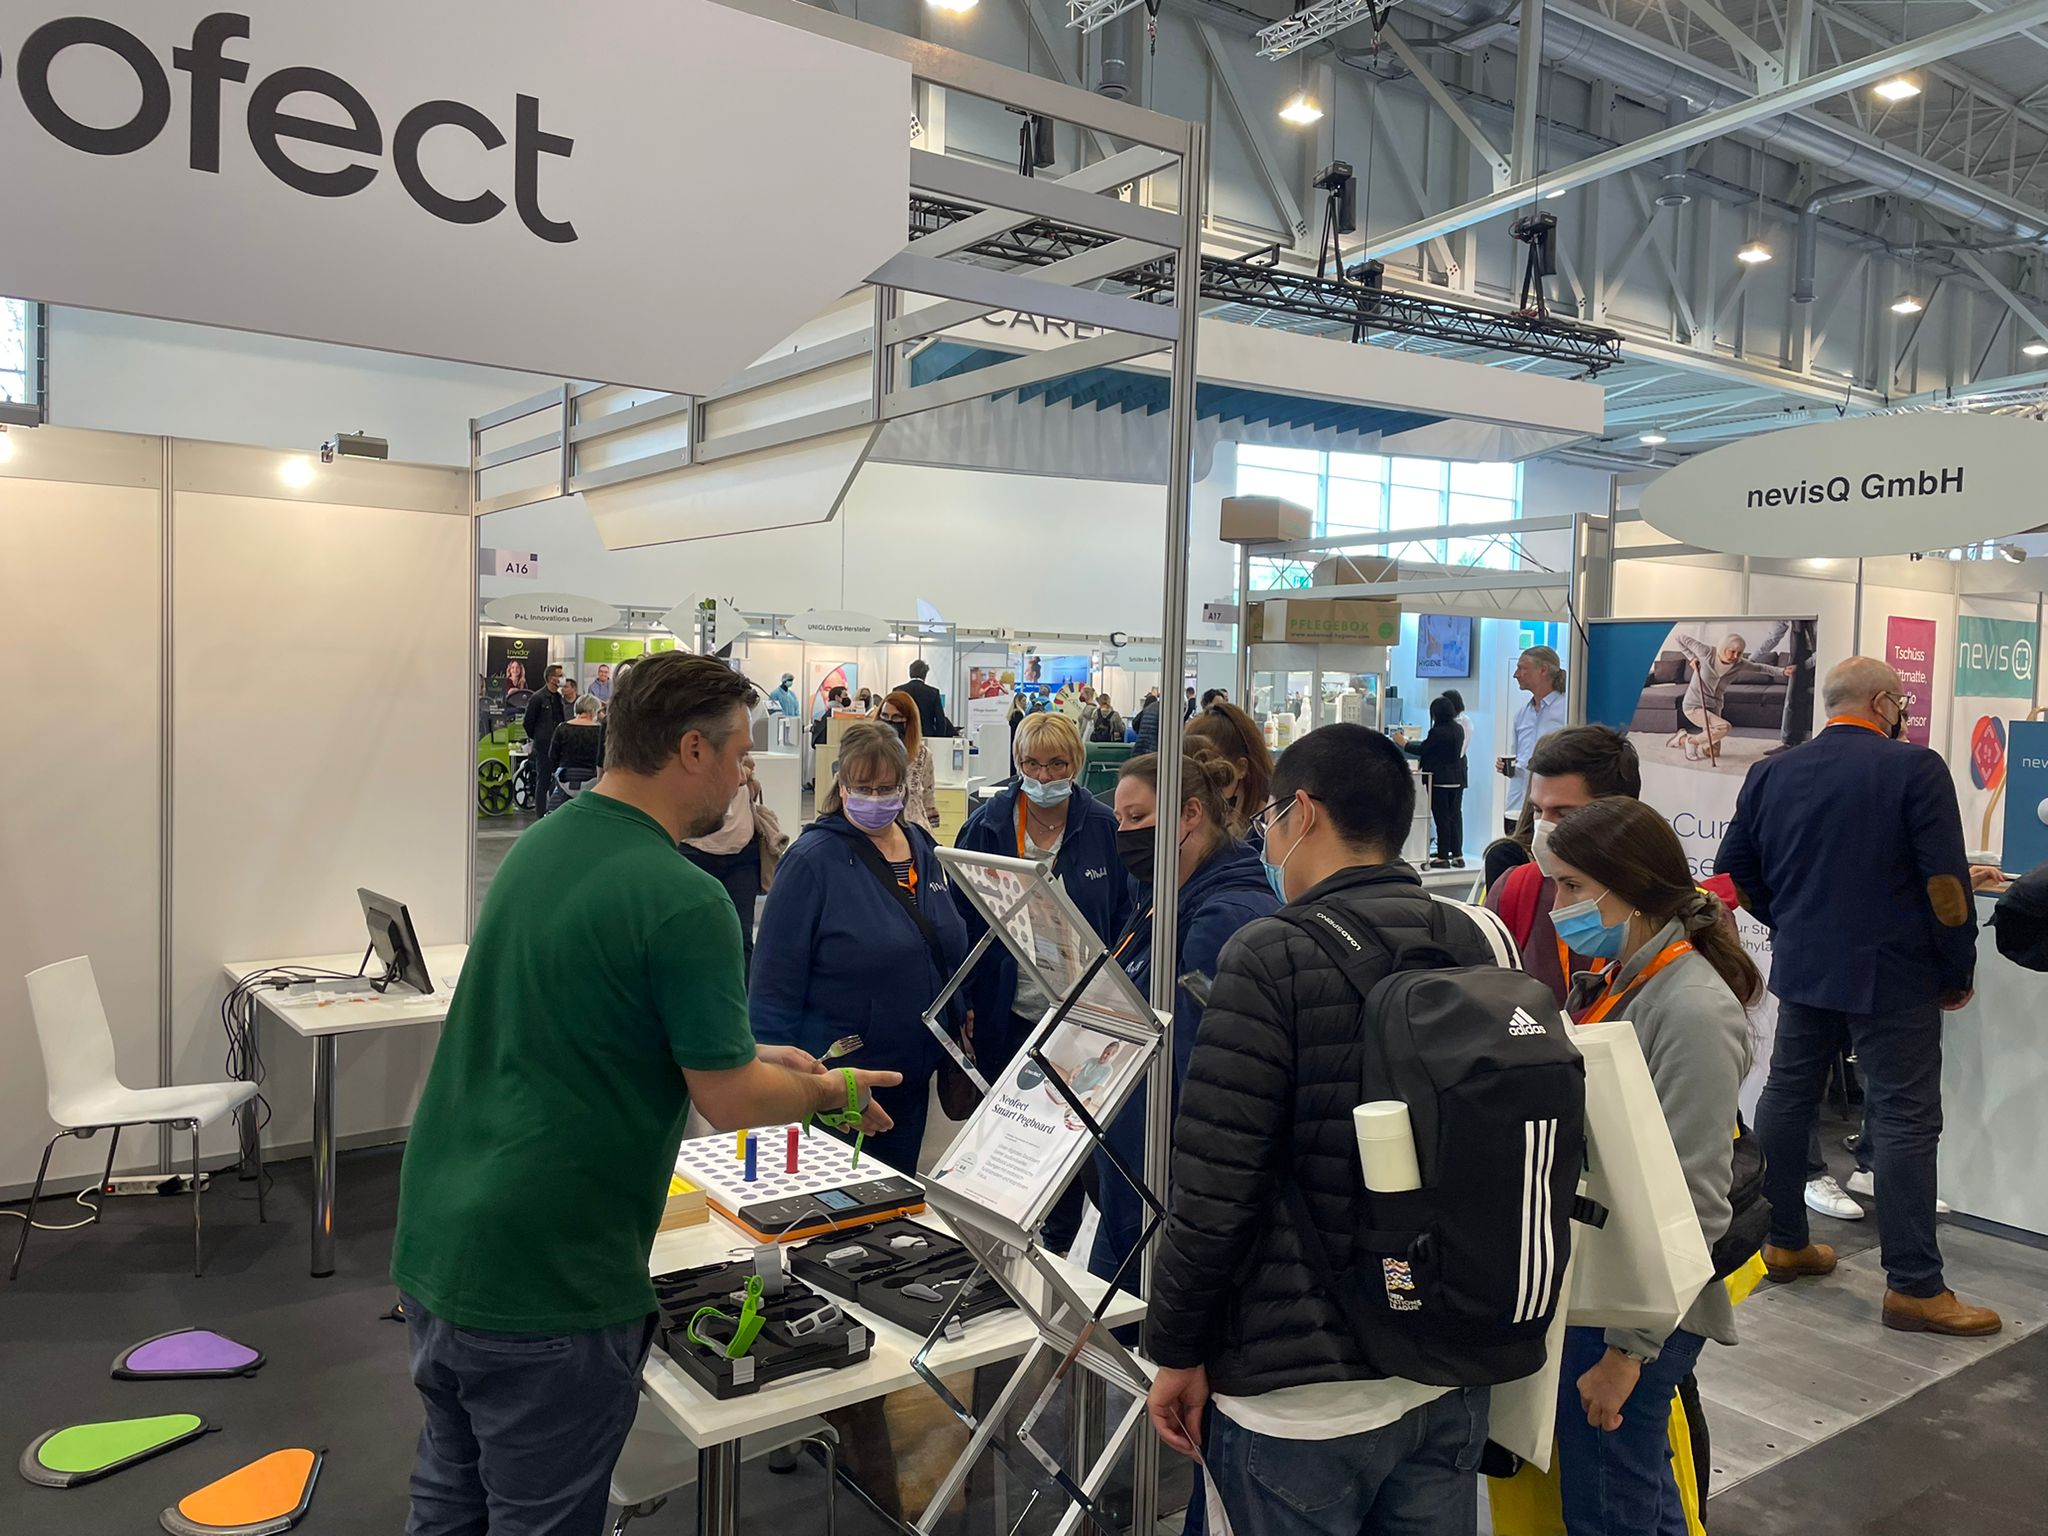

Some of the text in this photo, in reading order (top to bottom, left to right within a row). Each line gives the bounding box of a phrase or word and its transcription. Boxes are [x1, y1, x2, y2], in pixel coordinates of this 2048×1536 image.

[0, 11, 578, 243] ofect
[1748, 467, 1963, 508] nevisQ GmbH
[506, 563, 529, 574] A16
[540, 604, 569, 614] trivida
[1208, 612, 1221, 620] A17
[530, 614, 570, 622] Innovations
[1290, 618, 1370, 632] PFLEGEBOX
[1895, 646, 1925, 661] Tschüss
[1907, 716, 1927, 727] ensor
[1672, 812, 1731, 839] Cur
[1316, 912, 1361, 951] LOADSPRING
[1508, 1024, 1547, 1036] adidas
[999, 1094, 1030, 1112] Neofect
[992, 1104, 1056, 1135] Smart Pegboard
